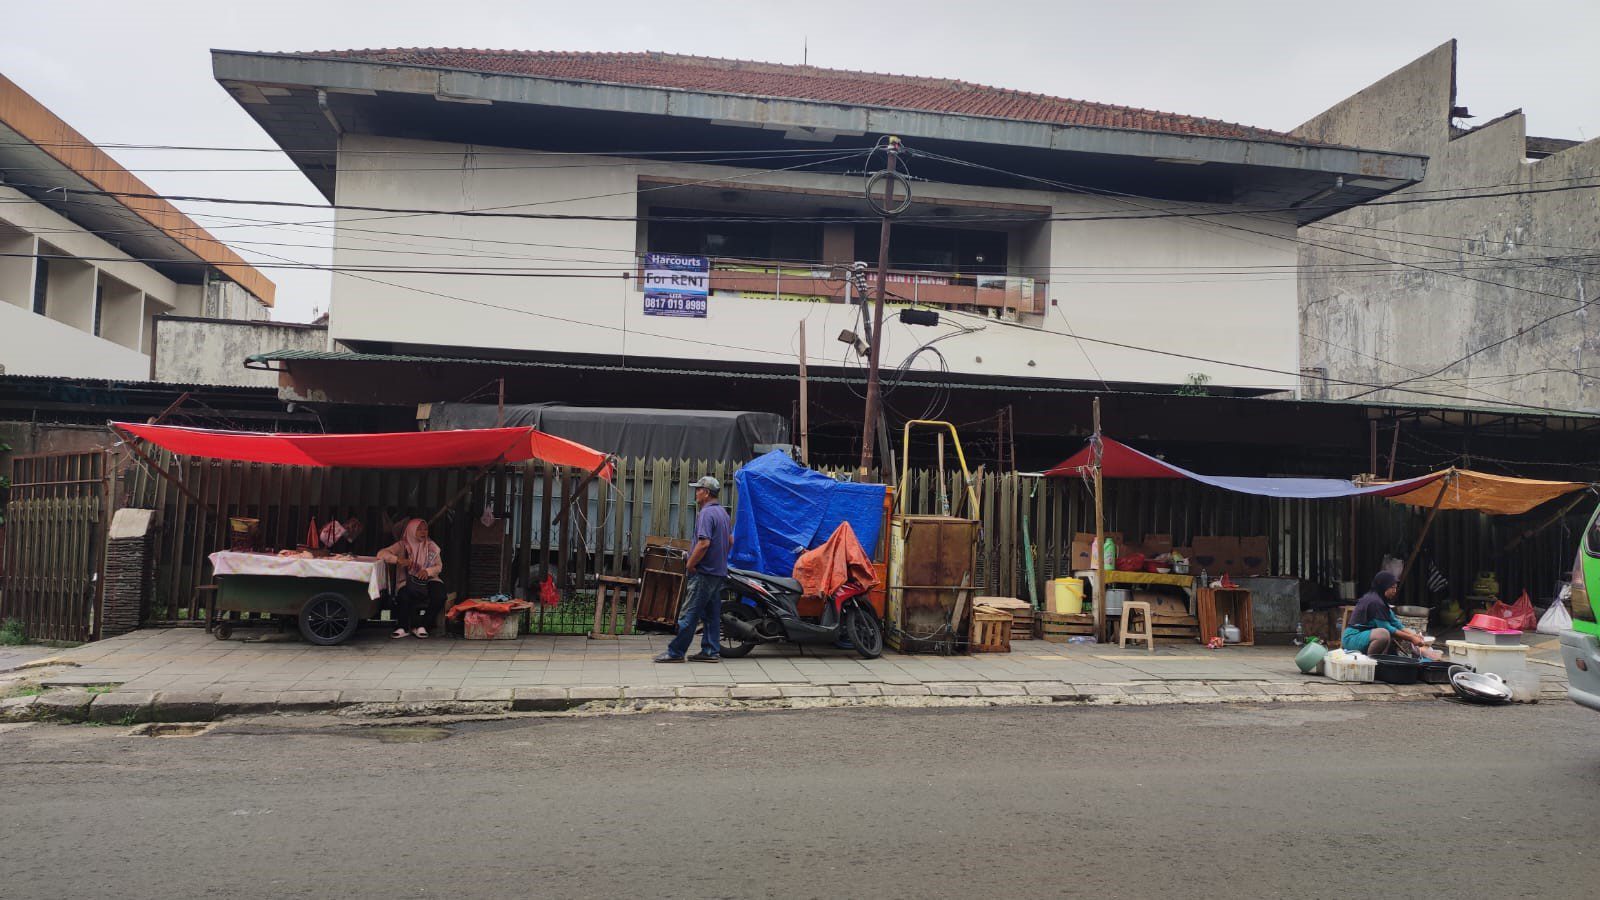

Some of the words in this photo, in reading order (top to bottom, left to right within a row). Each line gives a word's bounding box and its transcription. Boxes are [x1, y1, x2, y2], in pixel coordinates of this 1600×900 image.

[652, 254, 701, 267] Harcourts
[646, 272, 665, 285] For
[671, 274, 704, 288] RENT
[645, 297, 666, 309] 0817
[667, 298, 684, 310] 019
[685, 299, 706, 311] 8989
